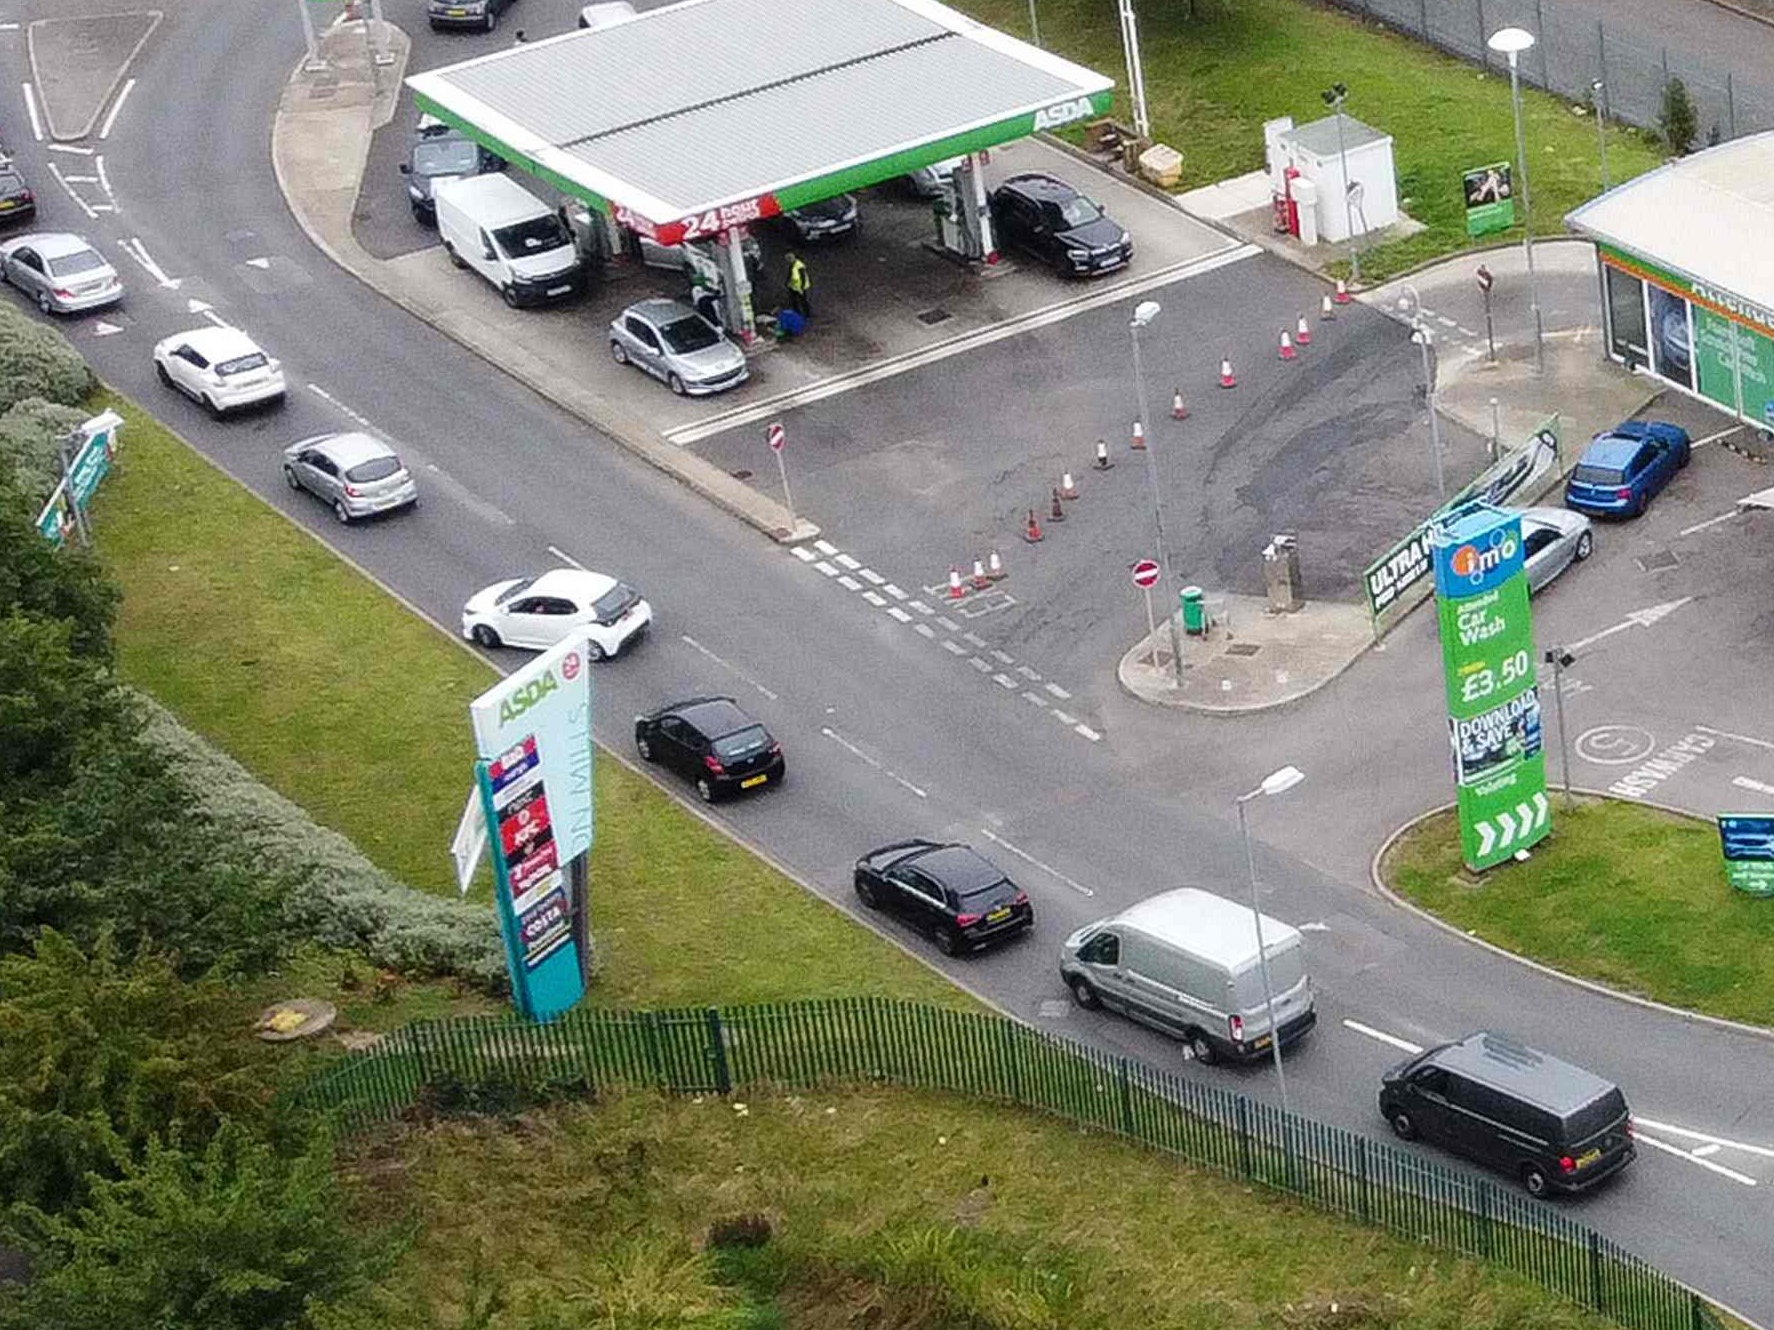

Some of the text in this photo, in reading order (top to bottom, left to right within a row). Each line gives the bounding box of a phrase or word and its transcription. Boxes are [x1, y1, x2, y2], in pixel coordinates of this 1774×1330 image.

[1033, 97, 1094, 132] ASDA
[681, 209, 721, 241] 24
[1371, 539, 1422, 596] ULTRA
[1458, 609, 1488, 631] Car
[1458, 617, 1506, 646] Wash
[1461, 649, 1529, 703] £3.50
[499, 669, 559, 728] ASDA
[1459, 688, 1537, 739] DOWNLOAD
[1475, 724, 1513, 752] SAVE
